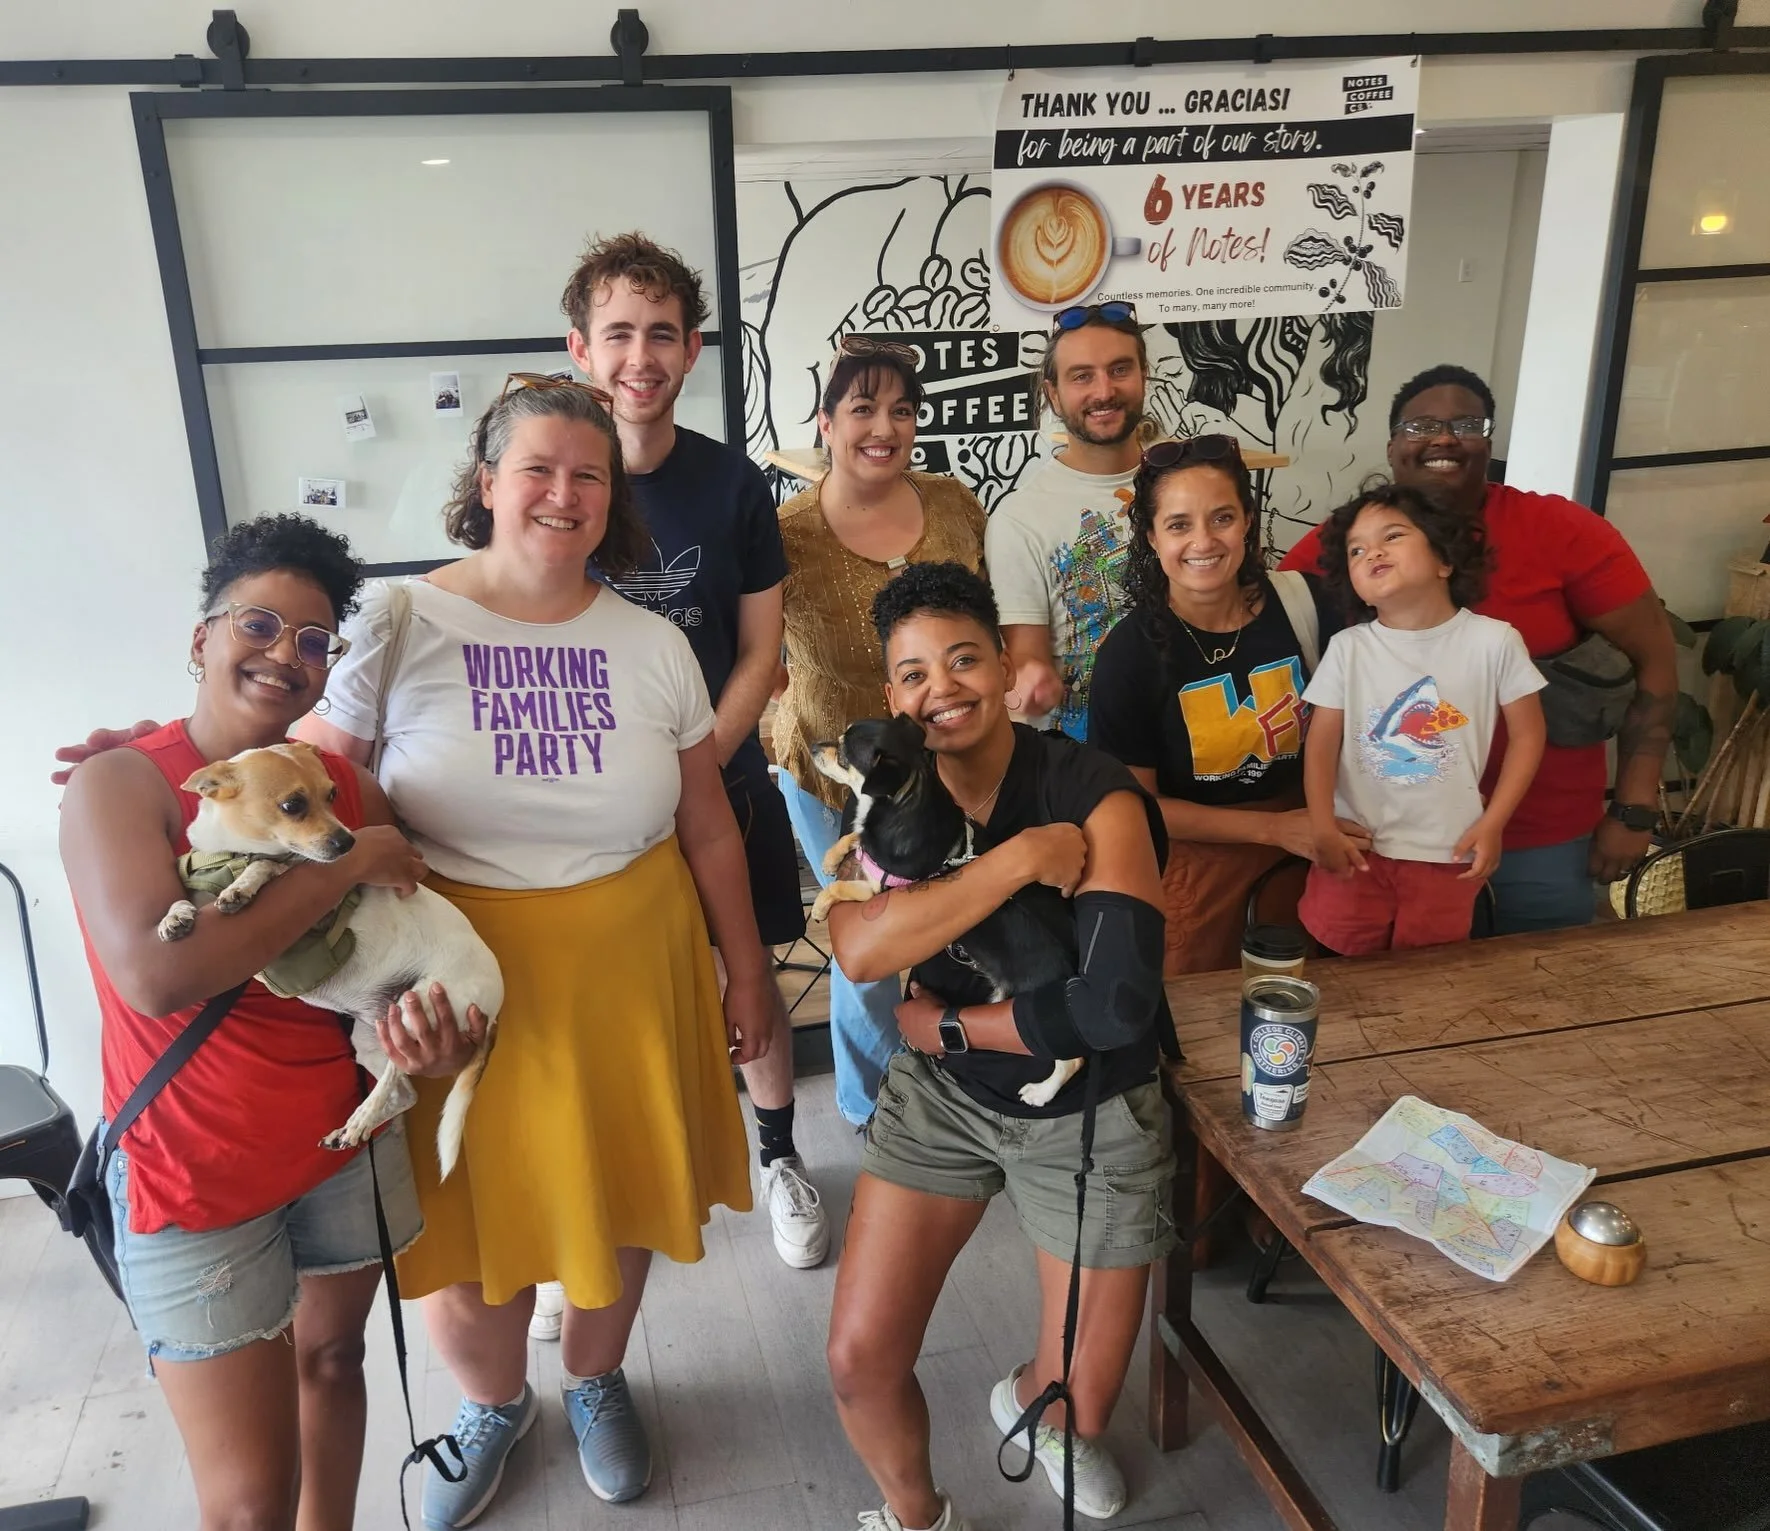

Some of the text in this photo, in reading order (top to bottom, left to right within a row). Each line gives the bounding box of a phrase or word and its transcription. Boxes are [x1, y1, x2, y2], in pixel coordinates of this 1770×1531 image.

[1347, 77, 1383, 87] NOTES
[1350, 90, 1391, 101] COFFEE
[1020, 92, 1098, 118] THANK
[1105, 90, 1151, 116] YOU
[1184, 87, 1291, 114] GRACIAS!
[1017, 123, 1323, 166] for being a part of our story.
[1143, 173, 1266, 226] 6 YEARS
[1147, 226, 1271, 272] of Notes!
[1097, 282, 1317, 302] Countless memories. One incredible community.
[1158, 300, 1255, 314] To many, many more!
[908, 338, 999, 373] OTES
[916, 392, 1028, 428] OFFEE
[462, 644, 610, 690] WORKING
[471, 689, 617, 732] FAMILIES
[494, 733, 603, 776] PARTY
[1253, 1026, 1284, 1043] COLLEGE
[1254, 1052, 1300, 1074] GATHERING
